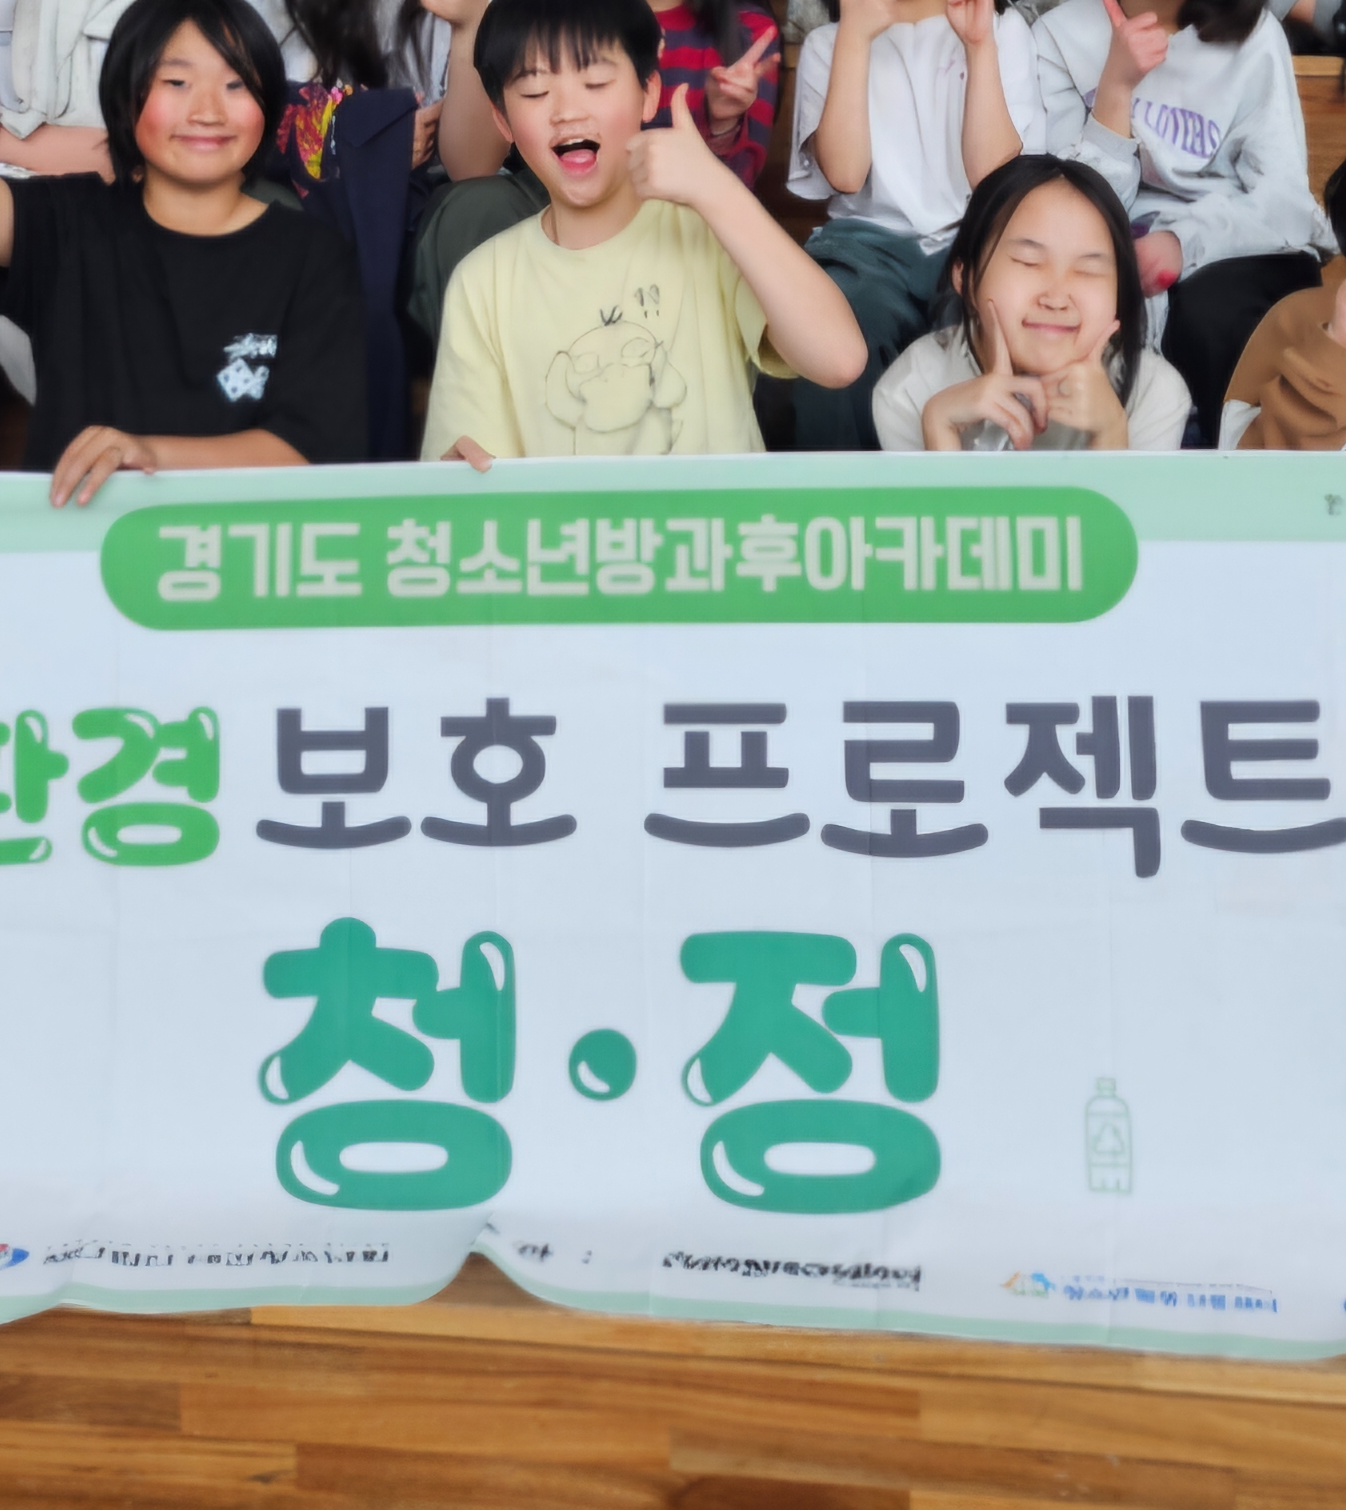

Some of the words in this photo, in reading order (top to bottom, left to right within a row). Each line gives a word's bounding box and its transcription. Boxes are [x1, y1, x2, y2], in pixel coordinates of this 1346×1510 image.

[156, 521, 364, 604] 경기도
[385, 513, 1085, 600] 청소년방과후아카데미
[256, 697, 578, 850] 보호
